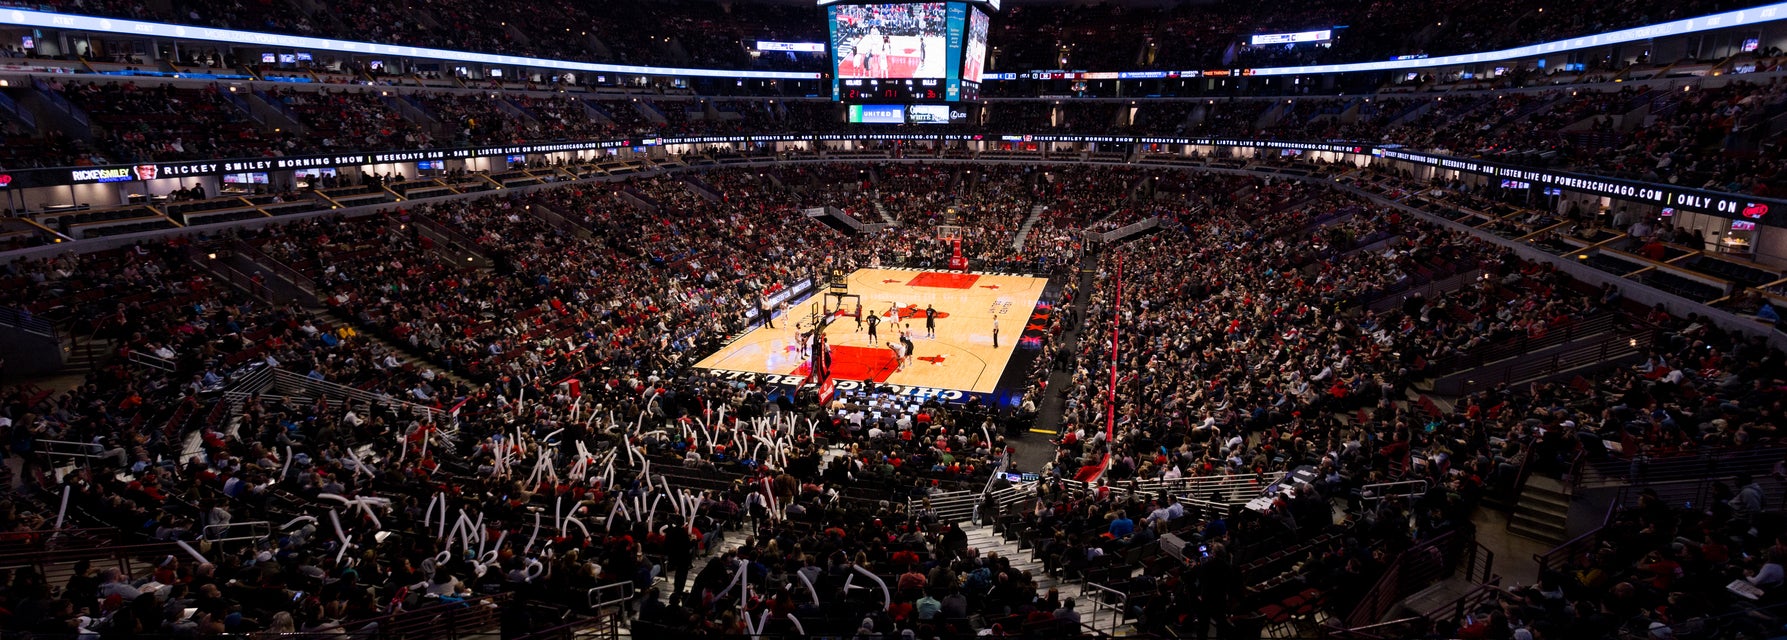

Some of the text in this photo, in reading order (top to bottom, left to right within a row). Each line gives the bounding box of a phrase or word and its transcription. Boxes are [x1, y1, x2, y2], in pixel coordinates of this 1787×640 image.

[164, 164, 217, 175] RICKEY
[225, 160, 272, 171] SMILEY
[278, 157, 330, 168] MORNING
[335, 155, 364, 164] SHOW
[376, 152, 424, 163] WEEKDAYS
[477, 148, 502, 156] LISTEN
[505, 146, 520, 154] LIVE
[522, 145, 532, 153] ON
[533, 142, 596, 152] POWER92CHICAGO.COM
[1385, 151, 1397, 159] RICKEY
[1397, 152, 1409, 160] SMILEY
[1410, 154, 1426, 163] MORNING
[1426, 156, 1438, 165] SHOW
[1442, 158, 1466, 170] WEEKDAYS
[1500, 167, 1522, 179] LISTEN
[1524, 171, 1539, 182] LIVE
[1541, 174, 1552, 183] ON
[1554, 175, 1663, 202] POWER92CHICAGO.COM
[1677, 193, 1711, 209] ONLY
[1717, 200, 1737, 213] ON
